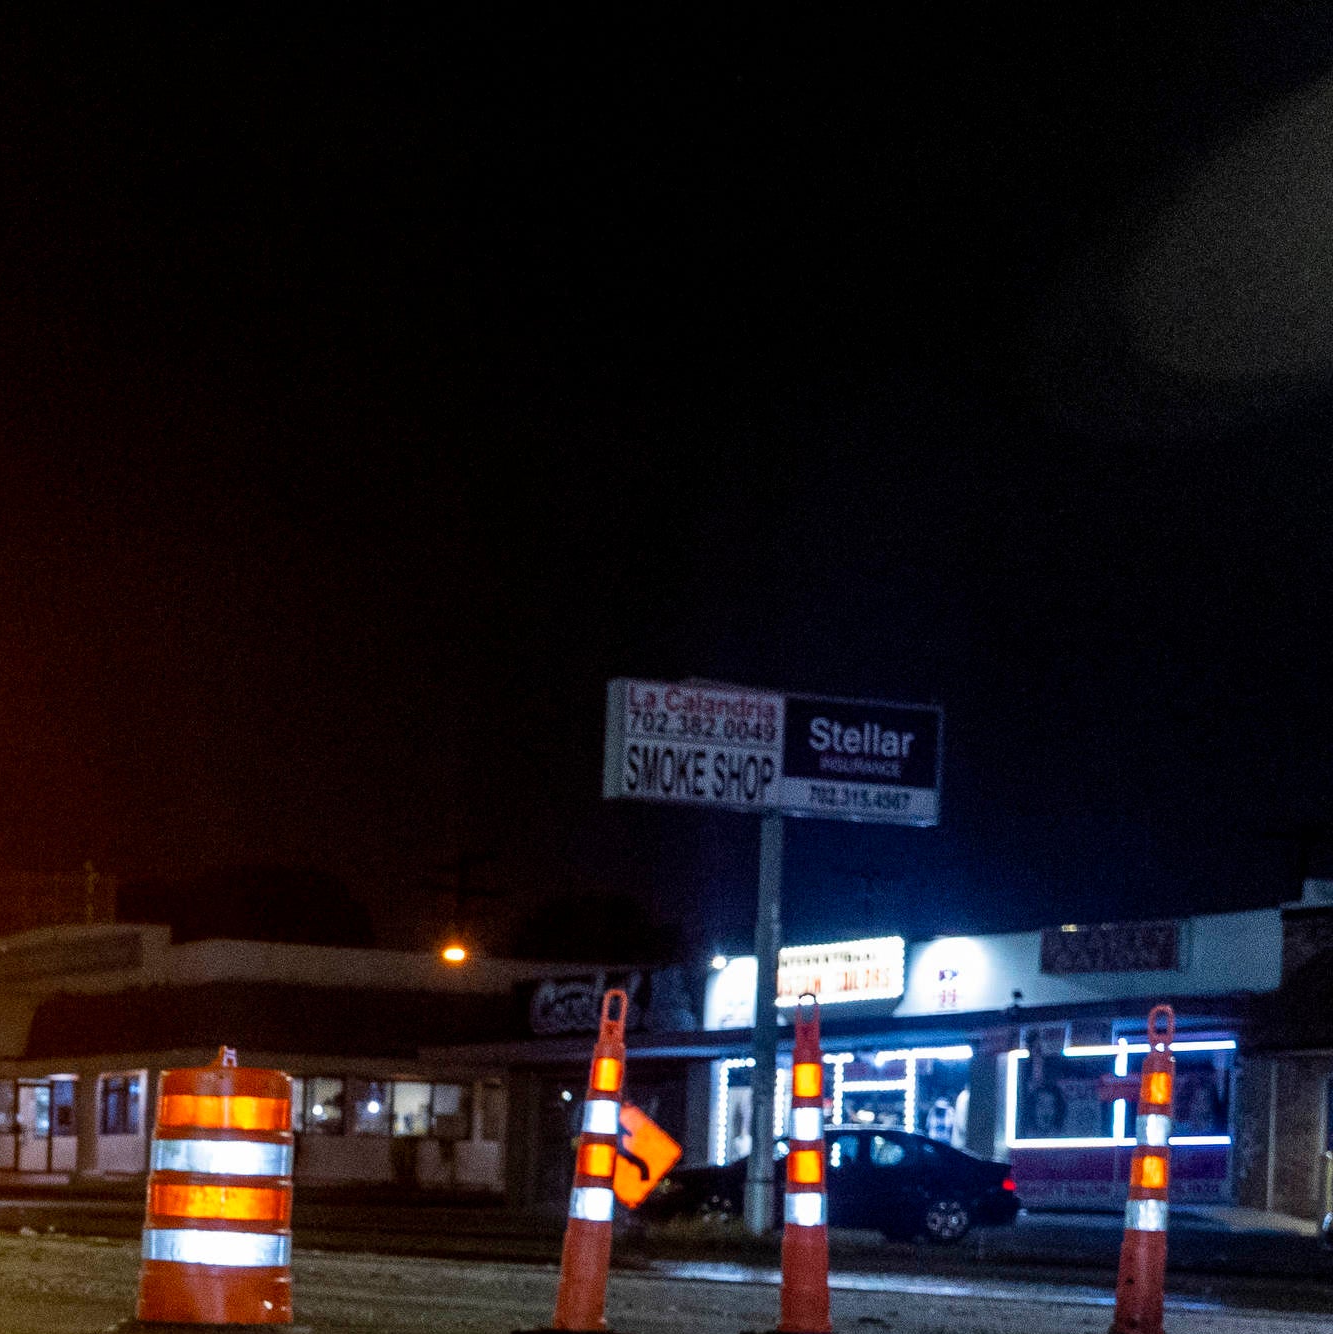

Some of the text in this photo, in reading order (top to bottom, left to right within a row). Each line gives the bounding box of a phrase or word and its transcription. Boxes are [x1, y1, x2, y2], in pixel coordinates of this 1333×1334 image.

[808, 716, 915, 758] Stellar
[627, 745, 775, 800] SMOKE SHOP
